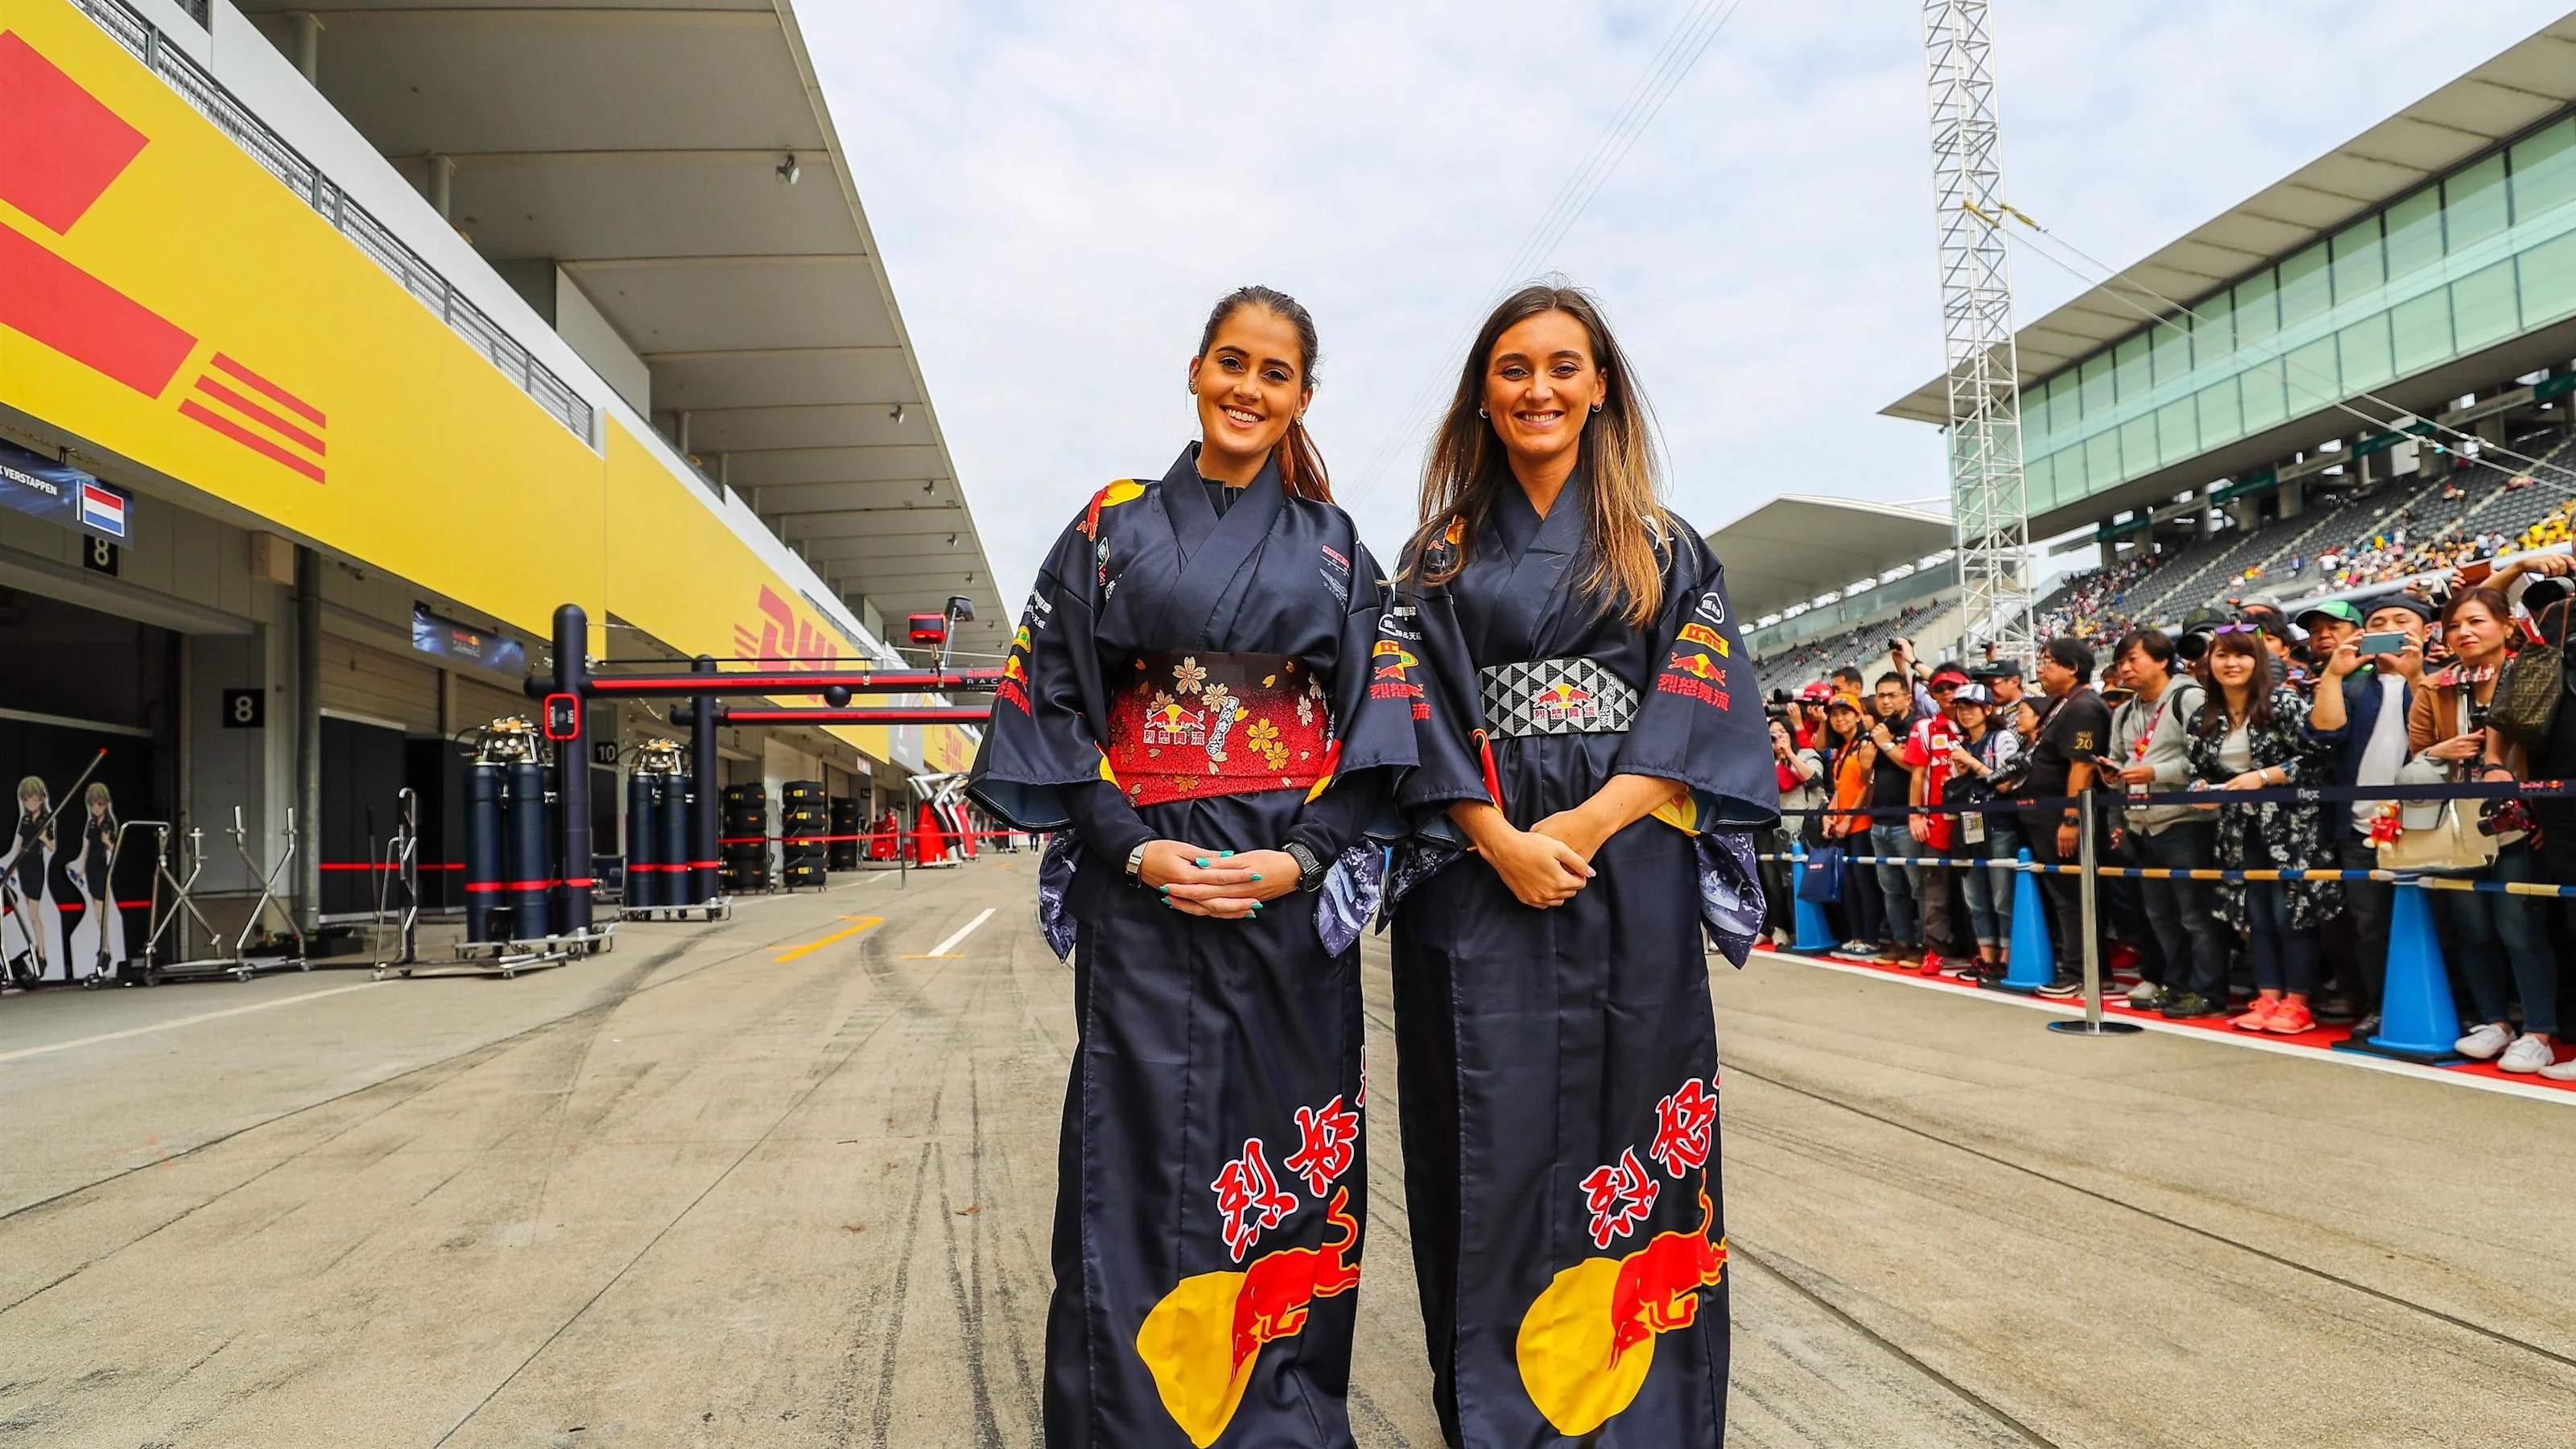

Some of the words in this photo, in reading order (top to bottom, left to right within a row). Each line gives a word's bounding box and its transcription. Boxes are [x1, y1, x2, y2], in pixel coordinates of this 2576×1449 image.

[4, 466, 57, 496] VERSTAPPEN
[94, 537, 109, 566] 8
[1657, 673, 1730, 712] 烈怒舞流
[234, 696, 253, 722] 8
[597, 745, 616, 762] 10
[1210, 1044, 1367, 1263] 烈怒
[1579, 1063, 1720, 1250] 烈怒
